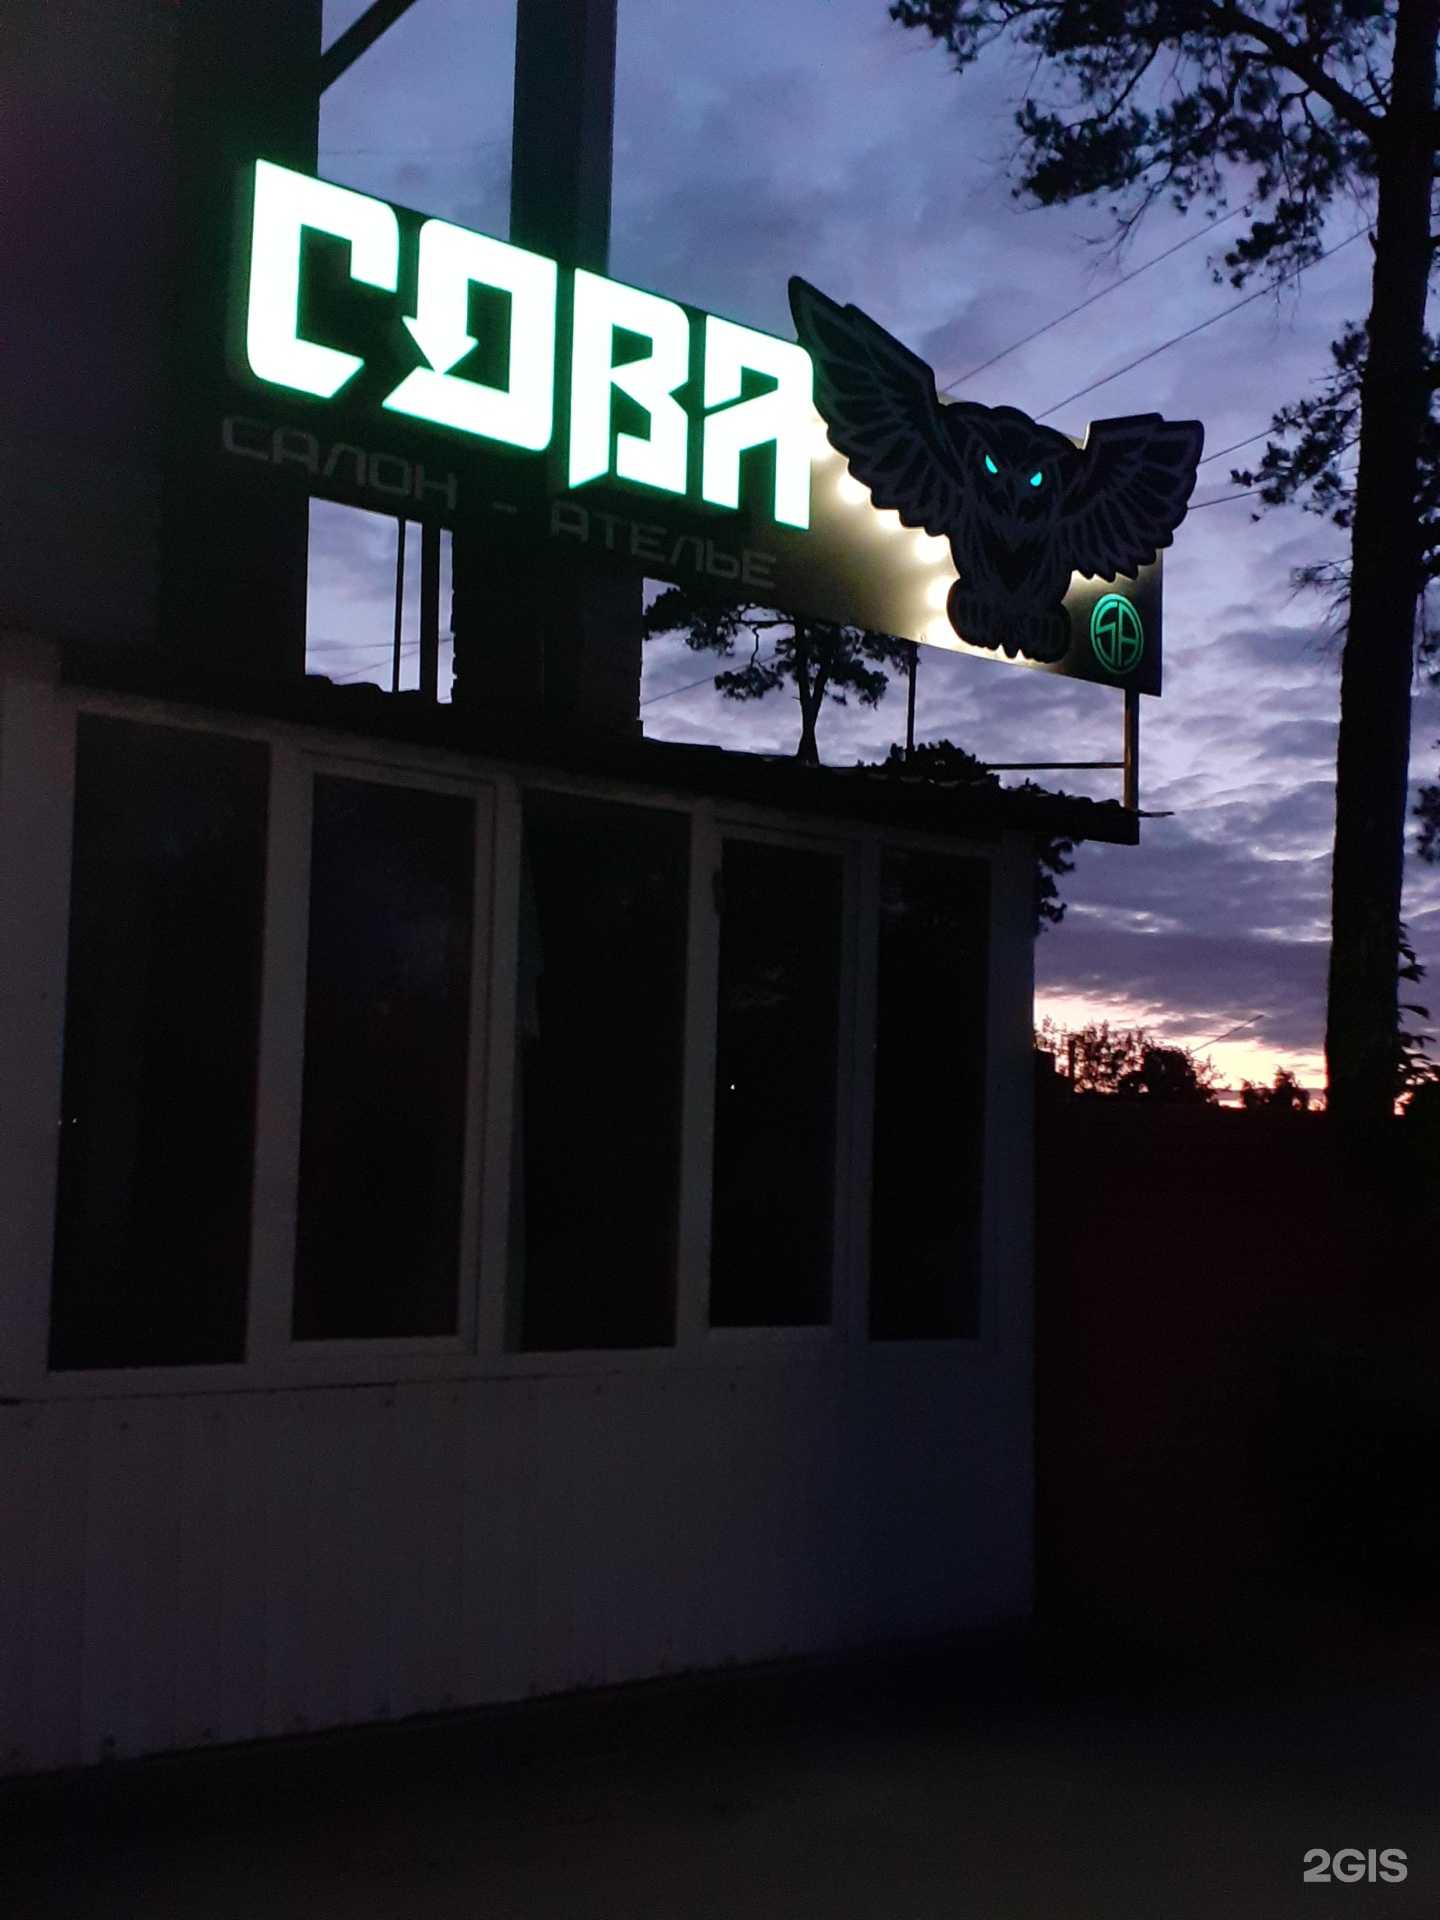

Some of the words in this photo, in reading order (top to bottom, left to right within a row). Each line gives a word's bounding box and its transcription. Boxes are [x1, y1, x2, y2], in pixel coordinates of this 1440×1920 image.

[246, 157, 814, 531] СОВА
[221, 415, 458, 512] САЛОН
[550, 500, 778, 591] АТЕЛЬЕ
